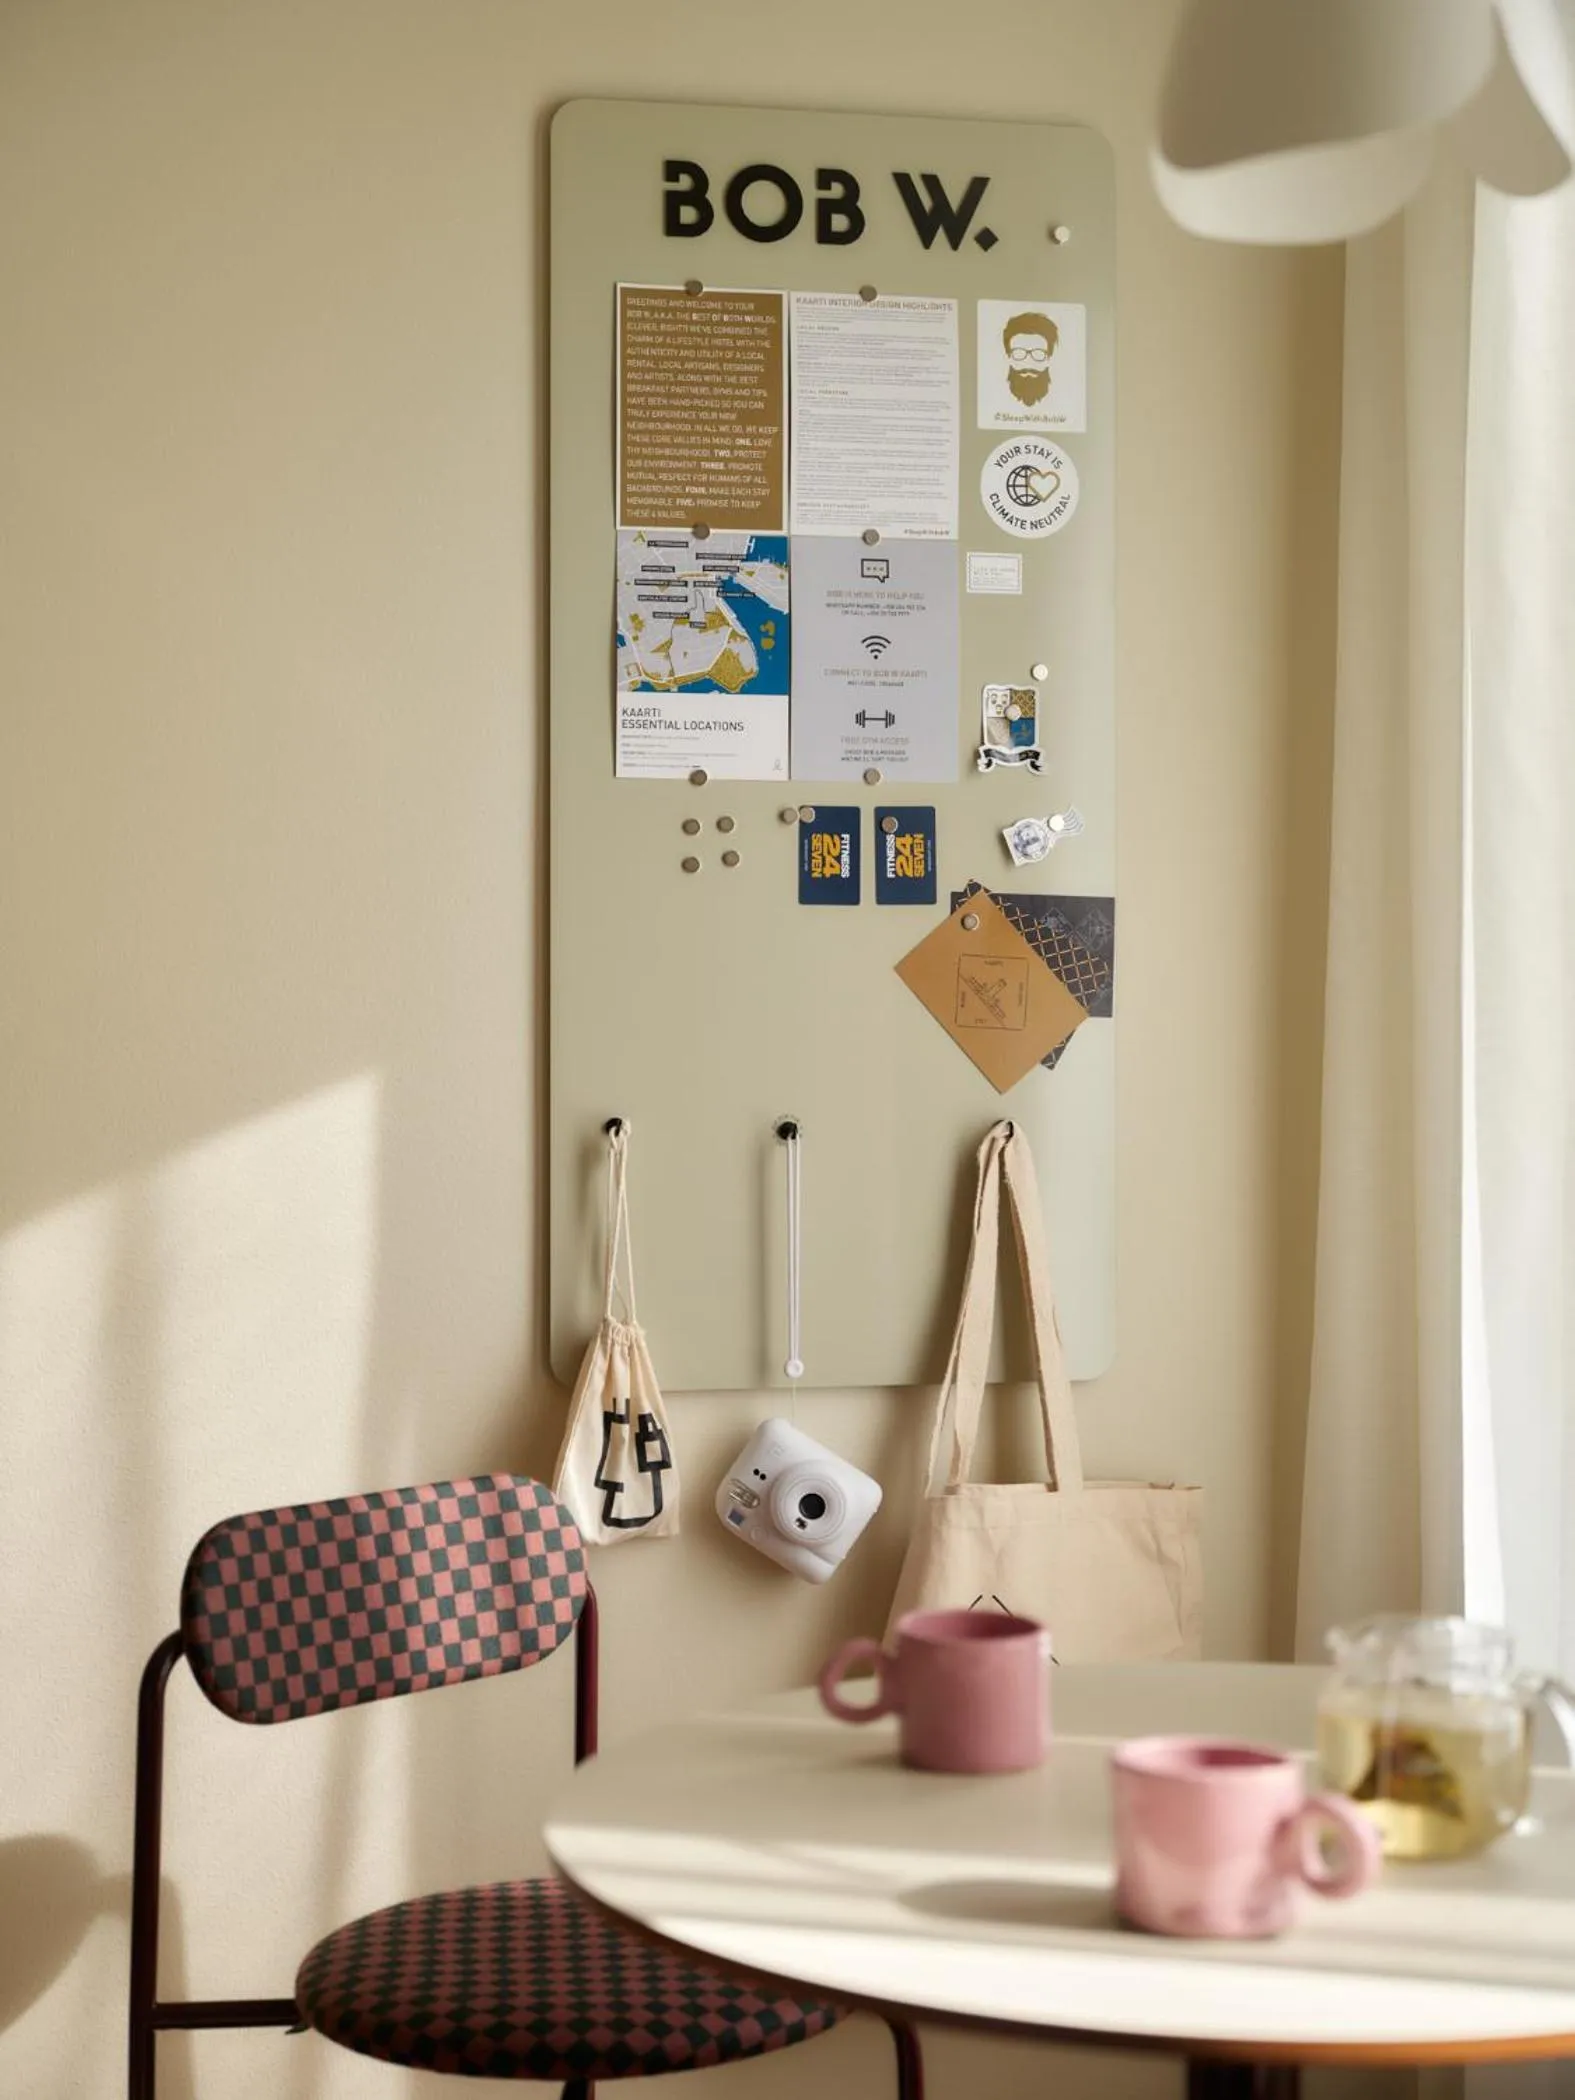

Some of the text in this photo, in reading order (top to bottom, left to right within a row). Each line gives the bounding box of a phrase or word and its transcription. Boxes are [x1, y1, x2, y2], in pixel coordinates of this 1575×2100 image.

[663, 158, 1000, 252] BOB W.
[993, 444, 1063, 470] YOUR STAY IS
[989, 493, 1027, 530] CLIMATE
[1029, 494, 1070, 530] NEUTRAL
[622, 707, 661, 717] KAARTI
[622, 719, 744, 732] ESSENTIAL LOCATIONS
[811, 833, 822, 878] SEVEN
[822, 833, 841, 878] 24
[841, 833, 850, 878] FITNESS
[886, 833, 896, 878] FITNESS
[895, 833, 914, 878] 24
[913, 833, 925, 878] SEVEN
